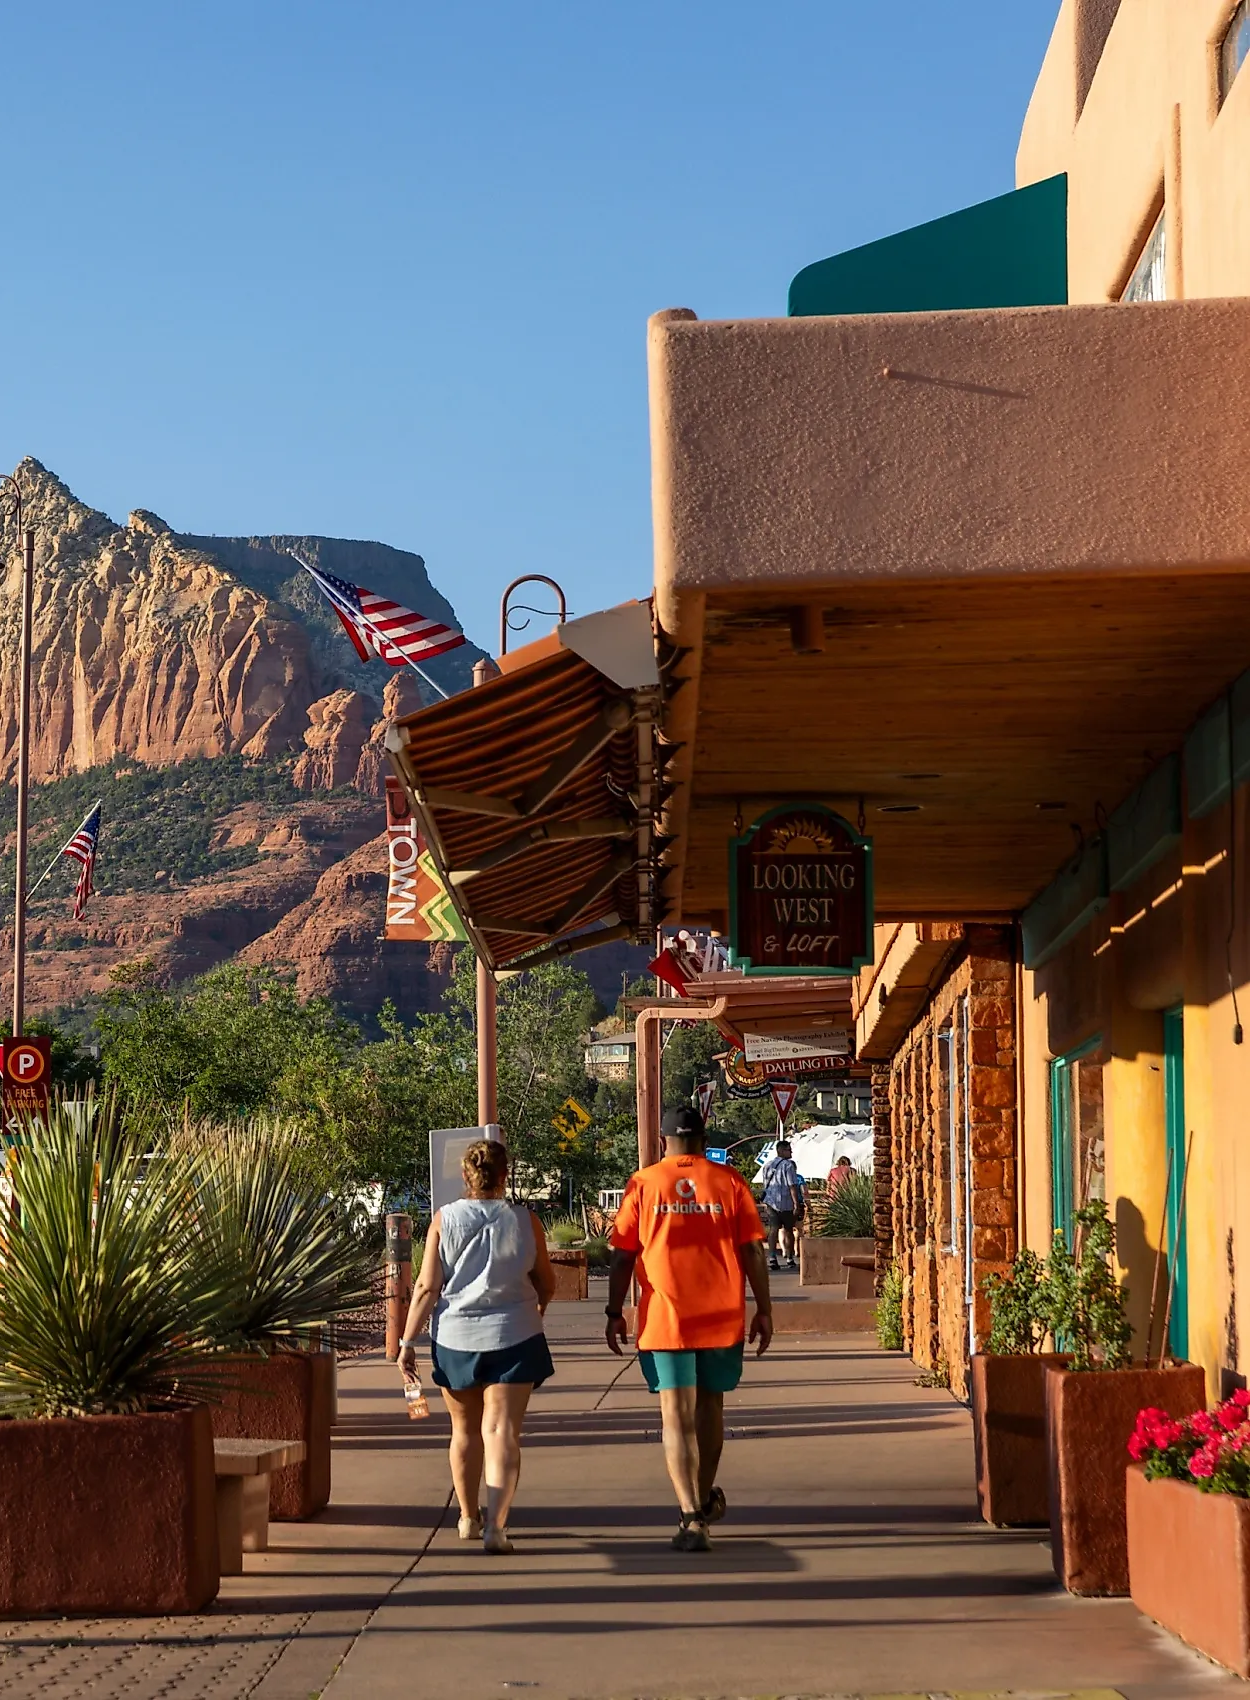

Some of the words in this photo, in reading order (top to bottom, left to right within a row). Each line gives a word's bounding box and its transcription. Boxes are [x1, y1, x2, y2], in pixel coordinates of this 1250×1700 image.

[753, 864, 855, 890] LOOKING
[773, 897, 834, 924] WEST
[764, 935, 780, 952] &
[786, 933, 840, 952] LOFT
[783, 1033, 822, 1043] Photography
[18, 1053, 35, 1075] P
[765, 1057, 822, 1074] DAHLING
[15, 1088, 36, 1098] FREE
[653, 1199, 723, 1214] vodafone
